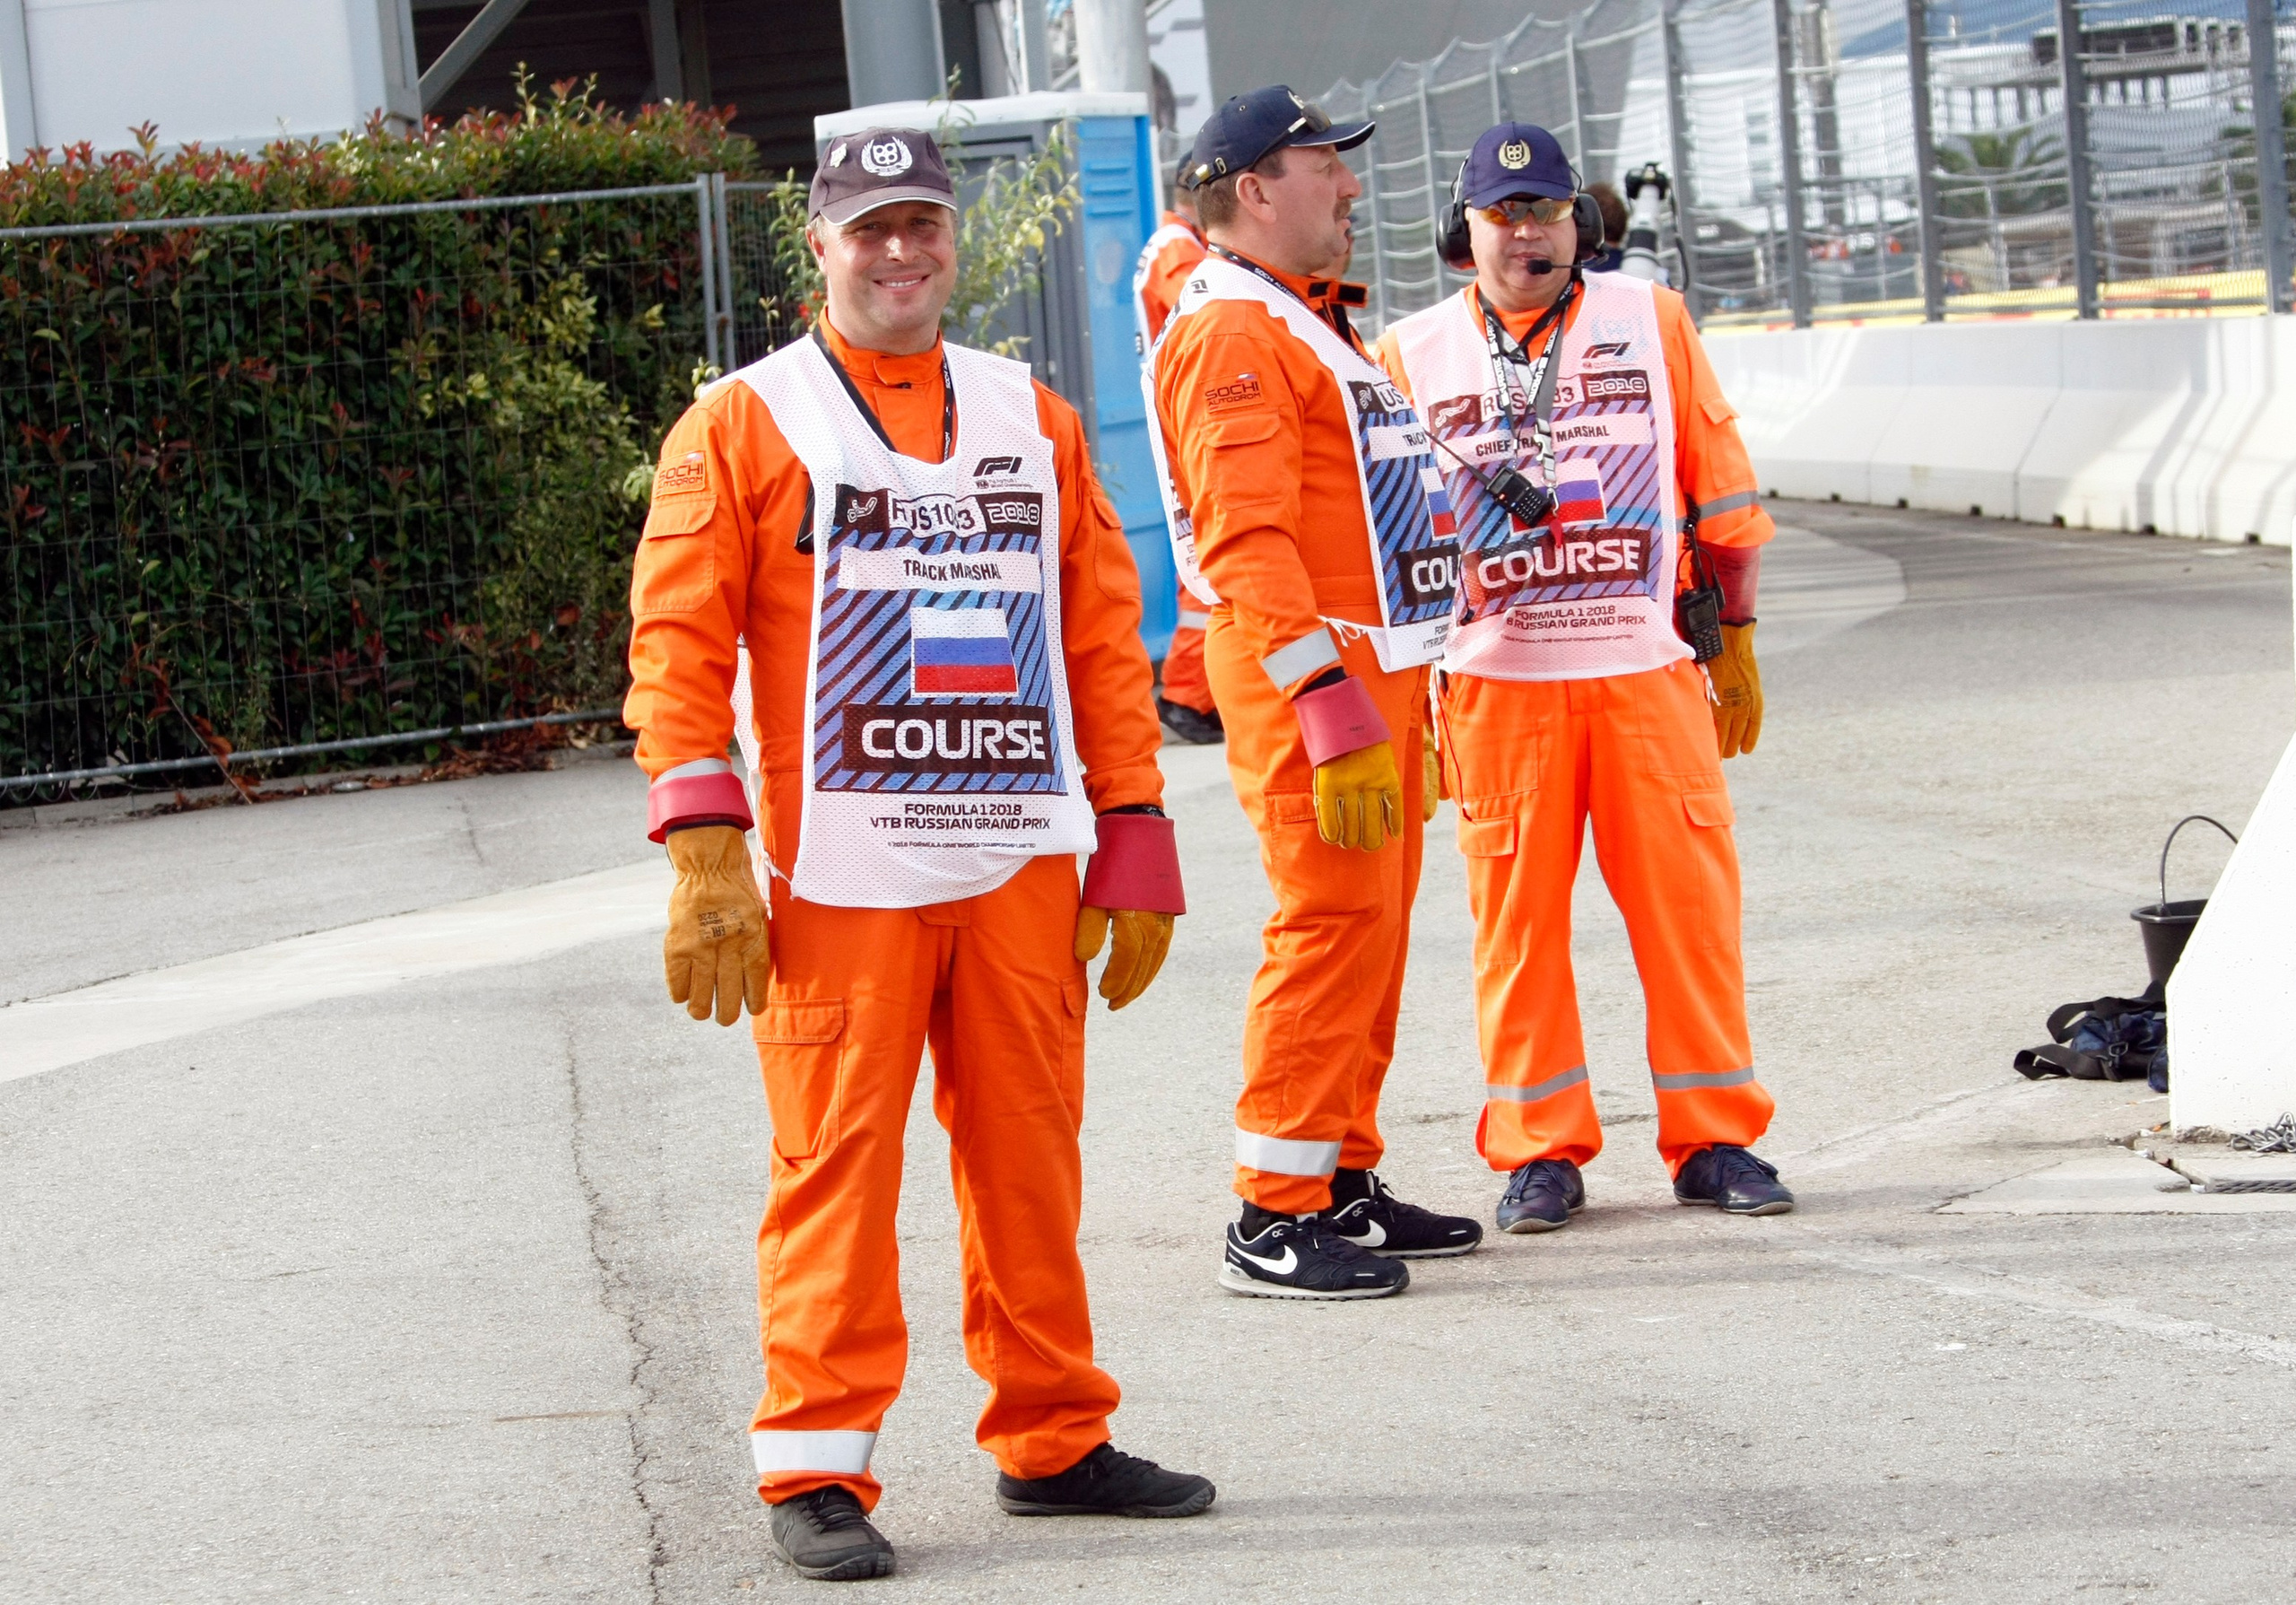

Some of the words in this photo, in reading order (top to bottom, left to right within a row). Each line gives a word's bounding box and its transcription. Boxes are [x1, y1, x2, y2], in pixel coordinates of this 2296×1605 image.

[1205, 380, 1260, 397] SOCHI
[1586, 377, 1648, 397] 2018
[1206, 392, 1262, 406] AUTODROM
[1475, 439, 1511, 457] CHIEF
[1556, 424, 1610, 442] MARSHAL
[658, 462, 703, 480] SOCHI
[972, 456, 1022, 476] F1
[984, 502, 1039, 526] 2018
[903, 559, 948, 581] TRACK
[1411, 554, 1462, 593] COU
[1476, 538, 1641, 589] COURSE
[1514, 618, 1568, 631] RUSSIAN
[1570, 615, 1615, 628] GRAND
[1617, 615, 1647, 625] PRIX
[1515, 608, 1575, 621] FORMULA
[1578, 607, 1584, 617] 1
[1587, 606, 1616, 616] 2018
[861, 719, 1047, 761] COURSE
[904, 804, 979, 816] FORMULA
[989, 804, 1022, 816] 2018
[870, 817, 901, 829] VTB
[904, 817, 973, 830] RUSSIAN
[975, 817, 1021, 830] GRAND
[1022, 817, 1051, 830] PRIX
